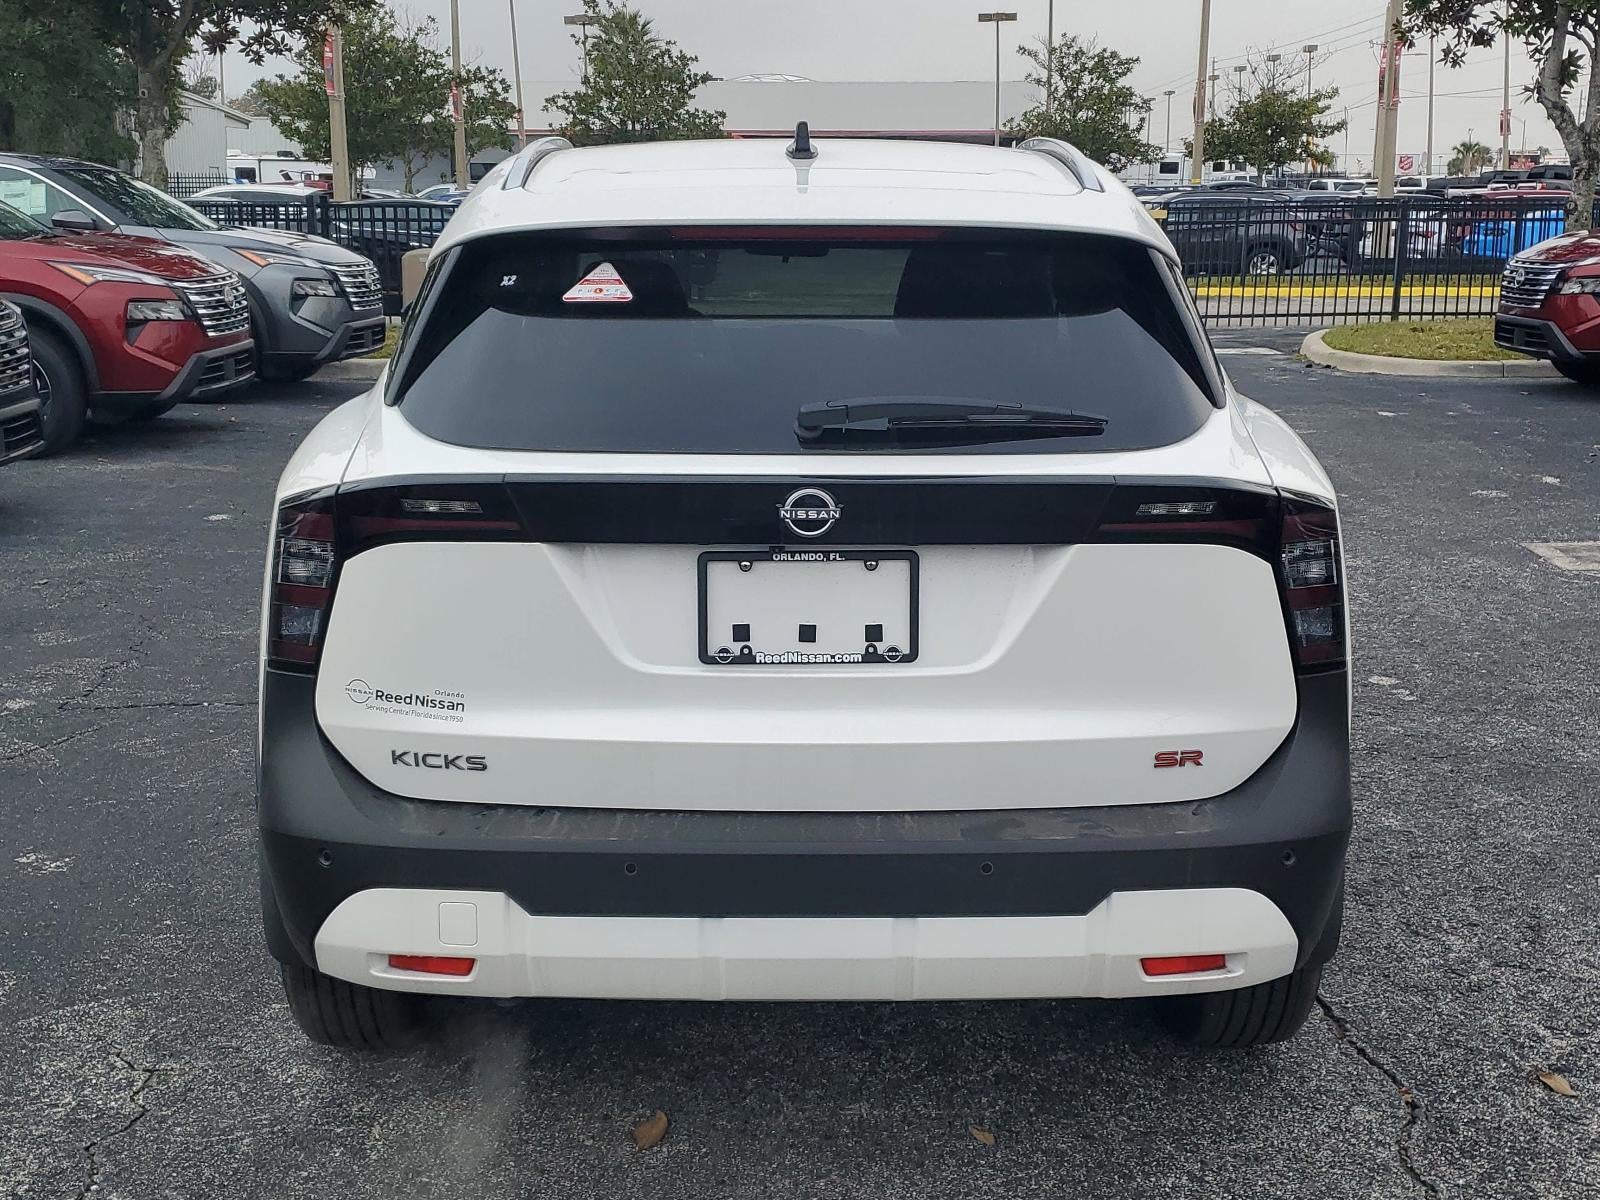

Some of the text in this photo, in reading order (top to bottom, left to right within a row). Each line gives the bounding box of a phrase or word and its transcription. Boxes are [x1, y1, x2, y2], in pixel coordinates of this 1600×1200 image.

[780, 510, 840, 518] NISSAN
[772, 552, 846, 561] ORLANDO, FL.
[755, 652, 862, 664] ReedNissan.com
[345, 687, 373, 696] NISSAN
[434, 689, 465, 698] Orlando
[375, 689, 465, 712] Reed Nissan
[391, 750, 487, 771] KICKS
[1154, 750, 1203, 768] SR
